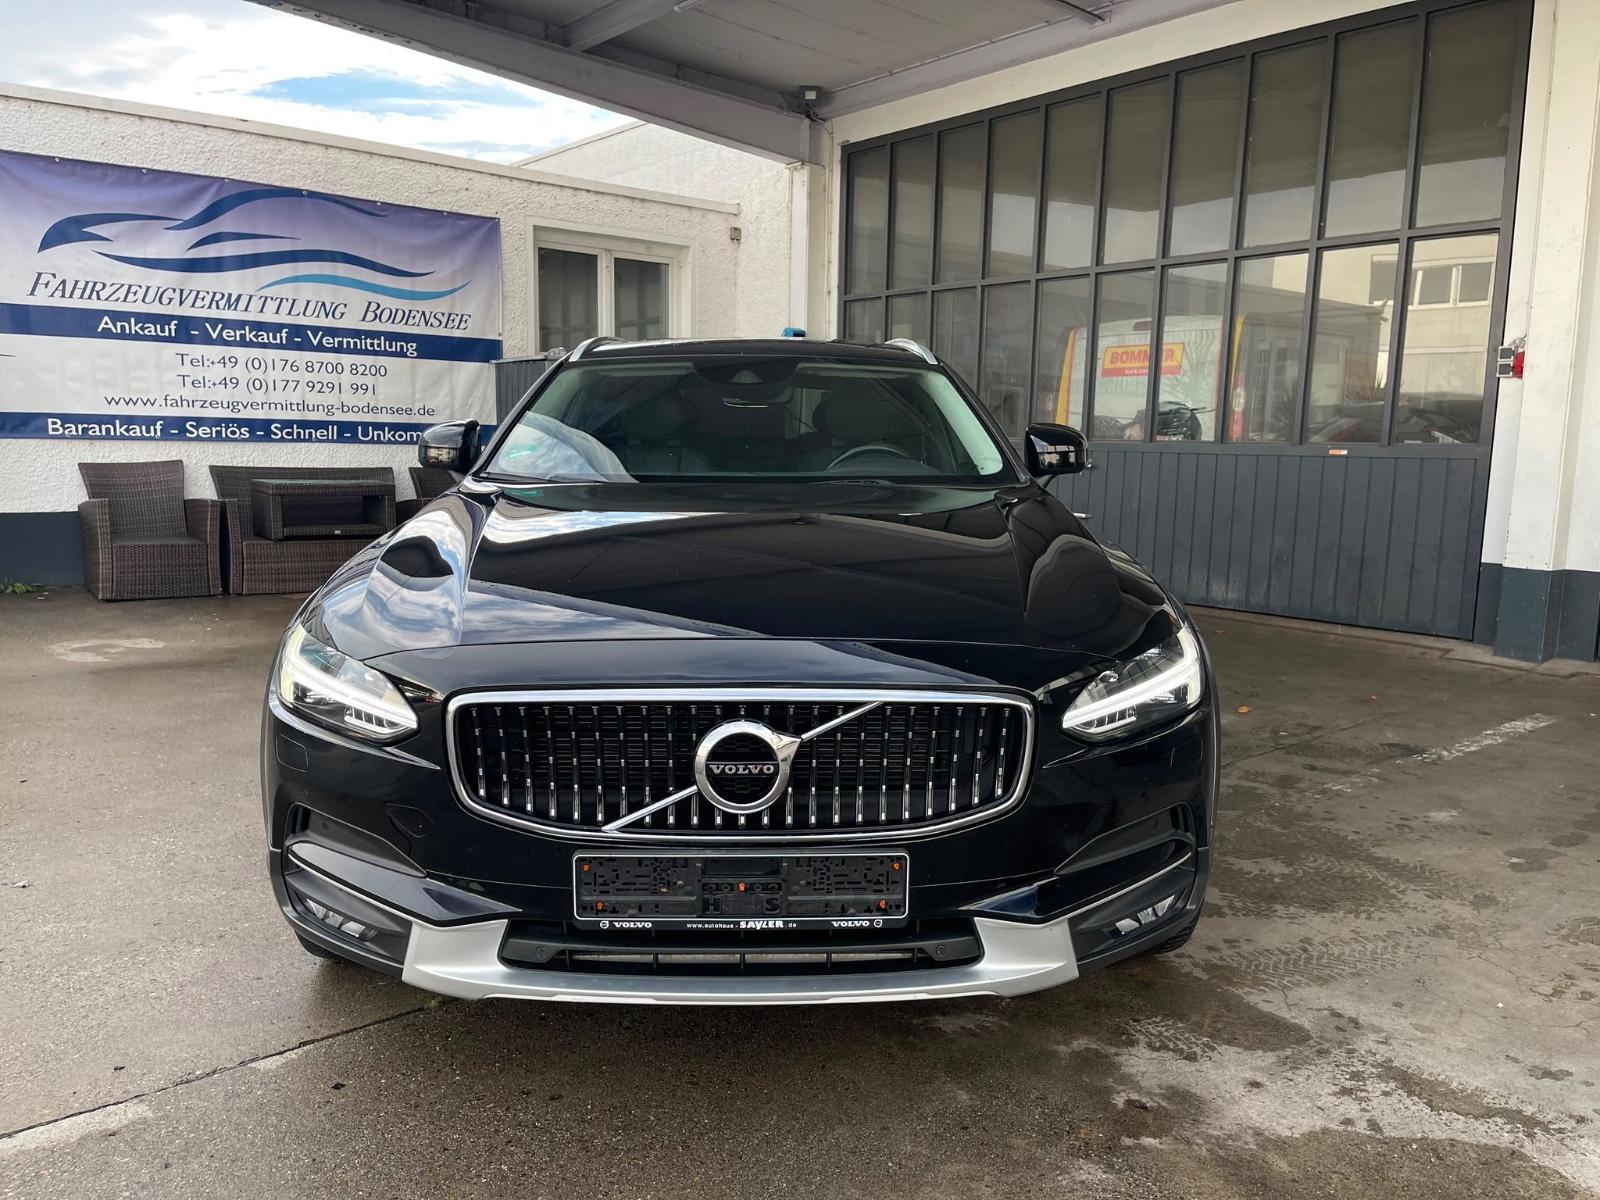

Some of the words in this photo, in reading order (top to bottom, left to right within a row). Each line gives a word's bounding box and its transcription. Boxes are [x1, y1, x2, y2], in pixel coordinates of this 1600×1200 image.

[27, 272, 347, 320] FAHRZEUGVERMITTLUNG
[360, 301, 471, 331] BODENSEE
[97, 316, 178, 338] Ankauf
[205, 323, 289, 345] Verkauf
[307, 330, 417, 357] Vermittlung
[245, 356, 300, 375] (0)176
[305, 360, 344, 375] 8700
[349, 363, 387, 377] 8200
[1109, 349, 1176, 365] BOMMR
[246, 377, 300, 396] (0)177
[305, 380, 342, 395] 9291
[350, 383, 376, 396] 991
[104, 395, 435, 416] www.fahrzeugvermittlung-bodensee.de
[47, 418, 163, 438] Barankauf
[186, 421, 250, 439] Seriös
[270, 423, 337, 440] Schnell
[709, 764, 774, 774] VOLVO
